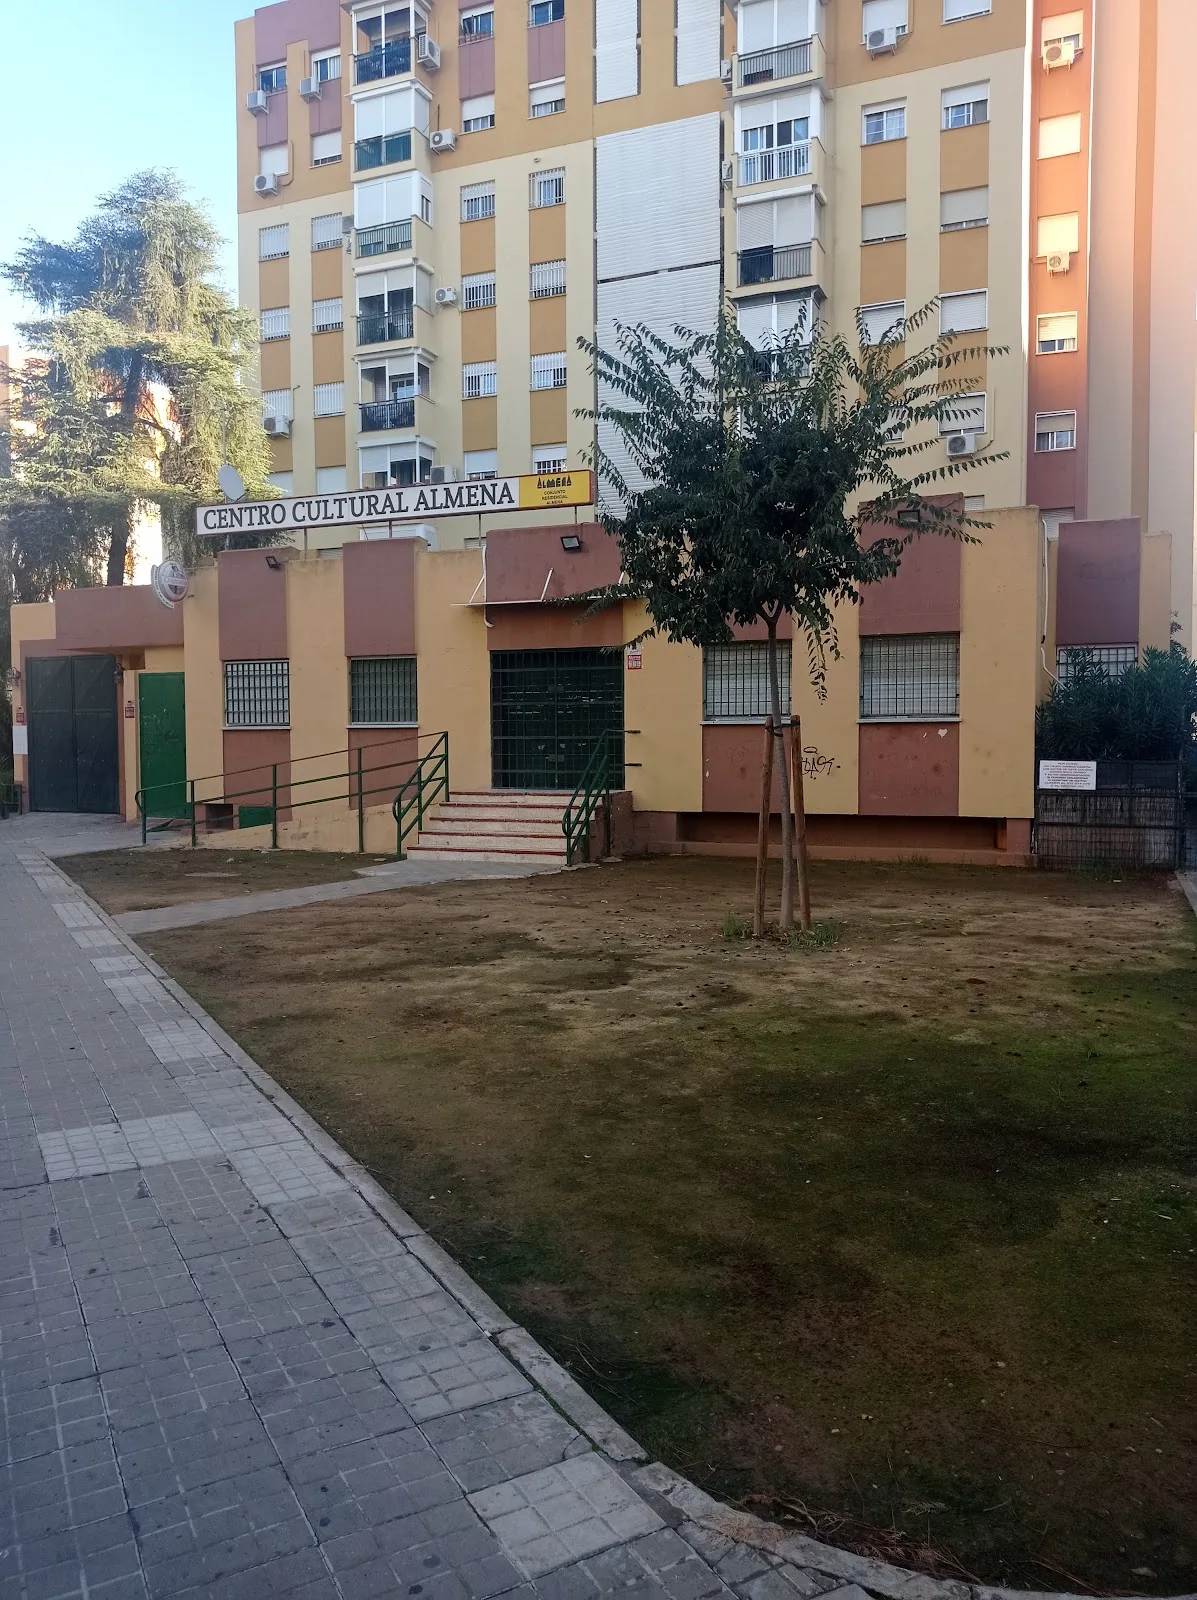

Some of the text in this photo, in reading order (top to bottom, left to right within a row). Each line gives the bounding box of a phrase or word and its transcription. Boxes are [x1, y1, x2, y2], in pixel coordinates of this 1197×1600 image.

[537, 474, 572, 489] ALMENA
[203, 481, 515, 530] CENTRO CULTURAL ALMENA
